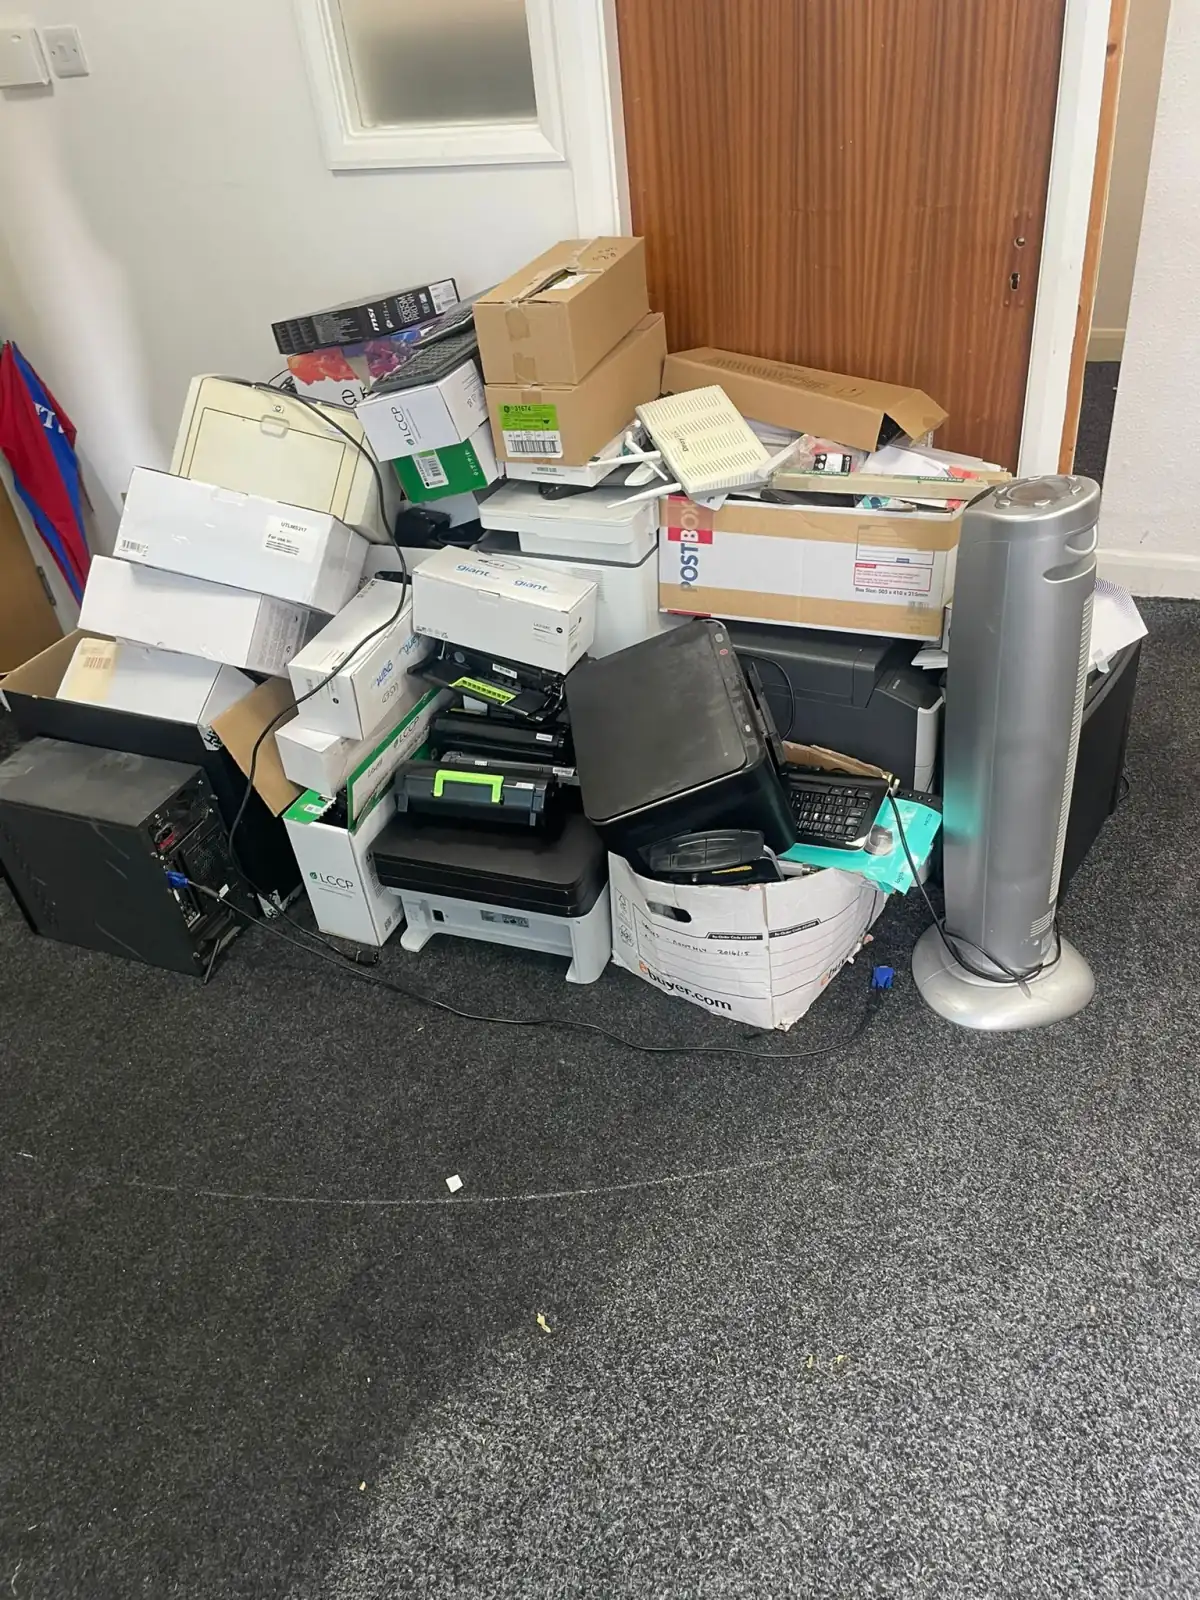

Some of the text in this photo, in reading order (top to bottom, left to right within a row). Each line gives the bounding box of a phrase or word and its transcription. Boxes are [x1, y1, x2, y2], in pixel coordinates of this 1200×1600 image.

[367, 308, 380, 332] msi
[390, 406, 412, 437] LCCP
[680, 499, 699, 593] POSTBOX
[456, 564, 491, 577] giant
[514, 580, 549, 592] giant
[319, 872, 354, 889] LCCP
[639, 960, 732, 1011] ebuyer.com
